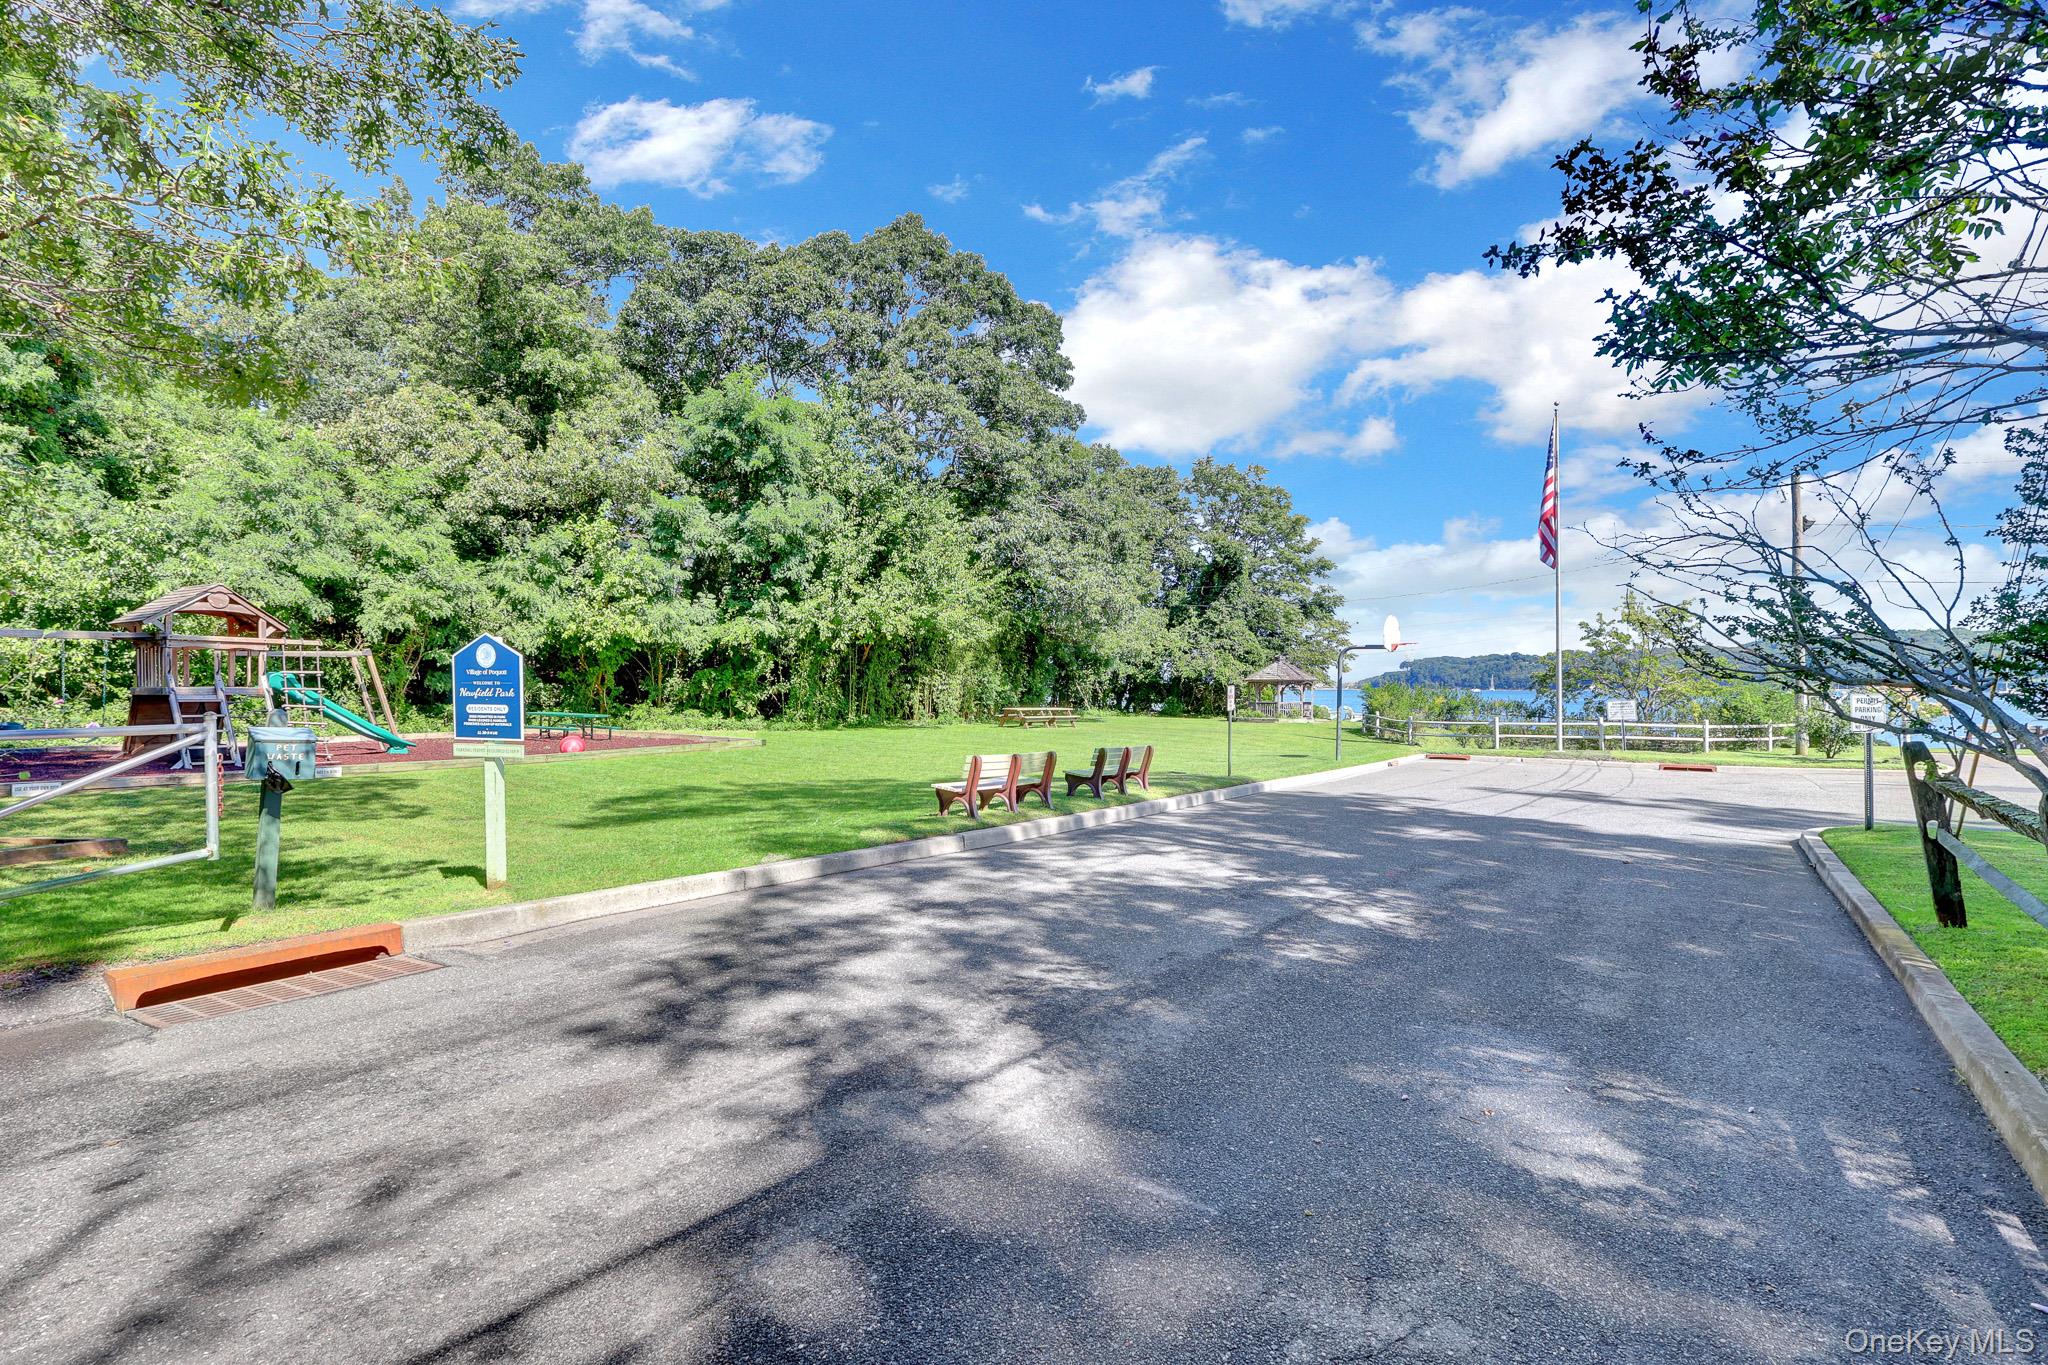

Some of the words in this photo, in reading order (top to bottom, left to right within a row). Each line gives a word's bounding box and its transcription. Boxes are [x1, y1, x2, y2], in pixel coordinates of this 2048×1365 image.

[459, 687, 493, 699] Newfield
[494, 687, 515, 697] Park
[266, 752, 305, 760] WASTE
